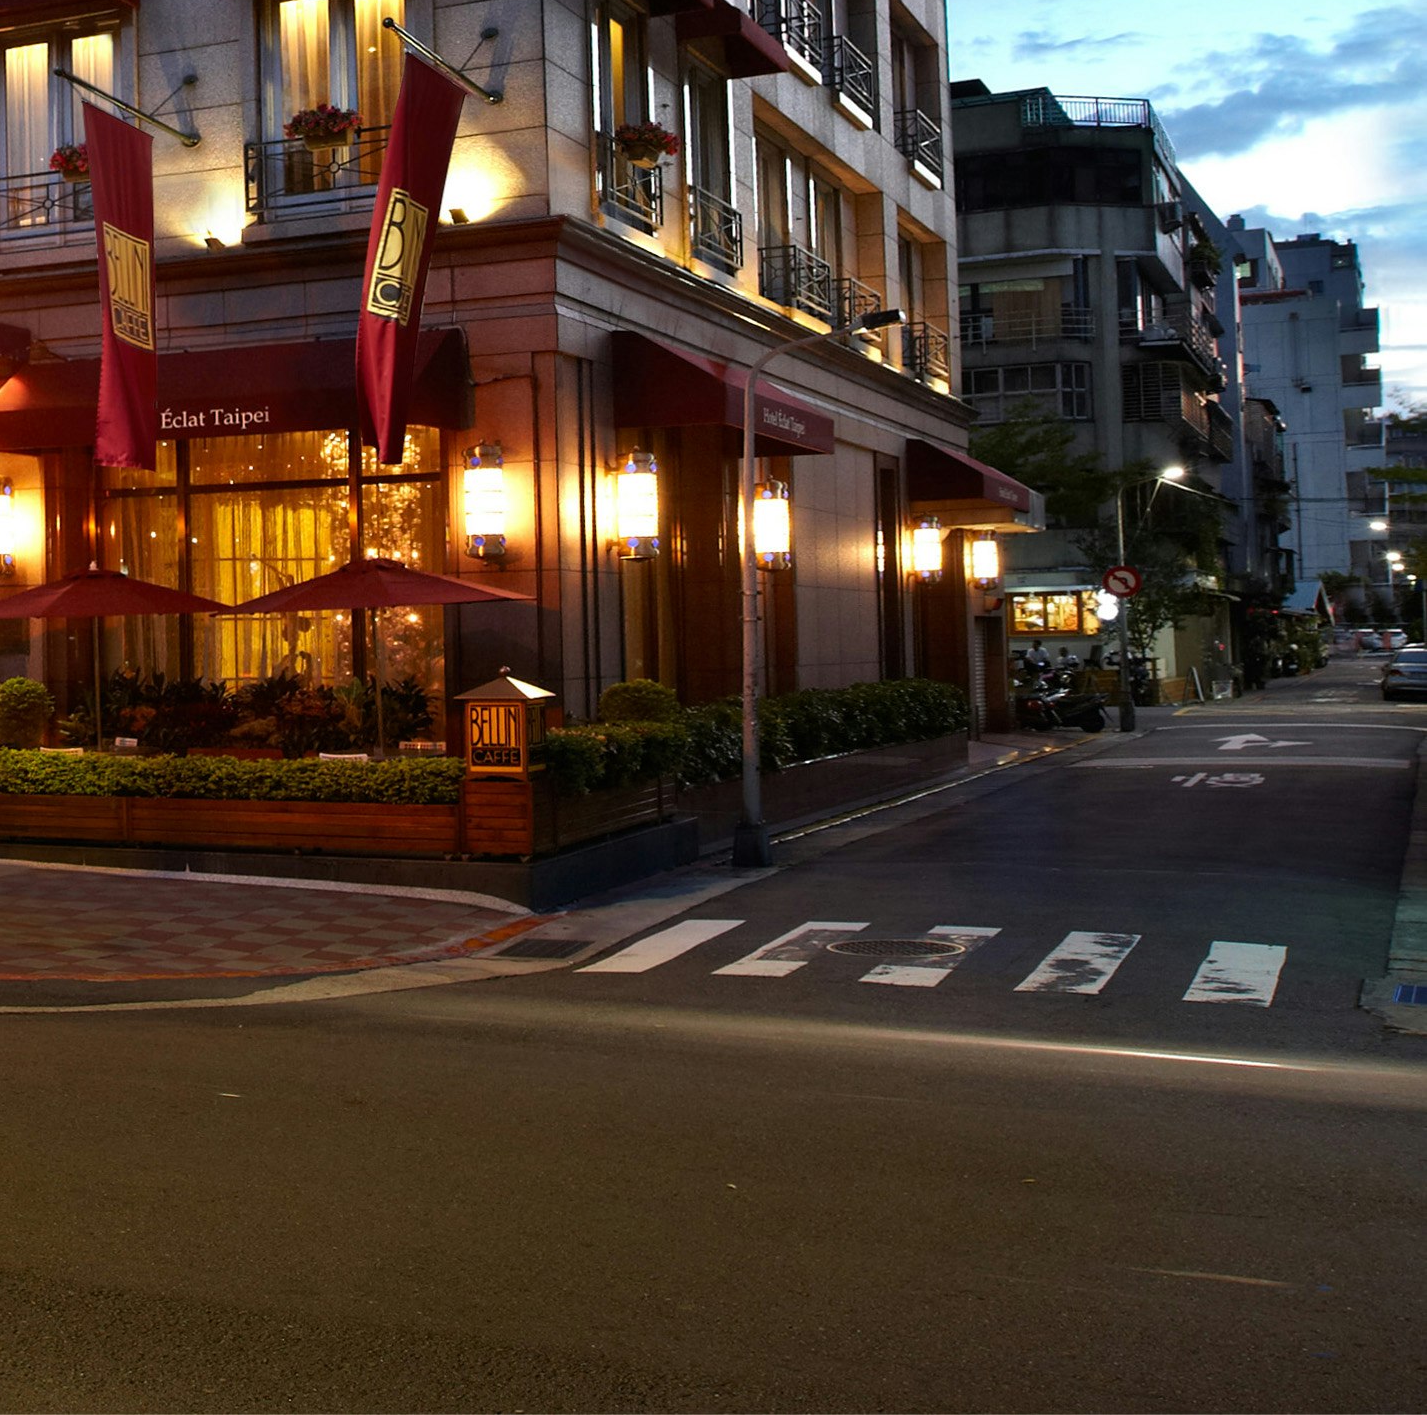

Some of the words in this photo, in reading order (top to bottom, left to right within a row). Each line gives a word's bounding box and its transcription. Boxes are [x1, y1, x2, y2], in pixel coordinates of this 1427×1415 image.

[160, 407, 206, 430] Éclat
[209, 405, 270, 430] Taipei
[470, 707, 521, 747] BELLINI
